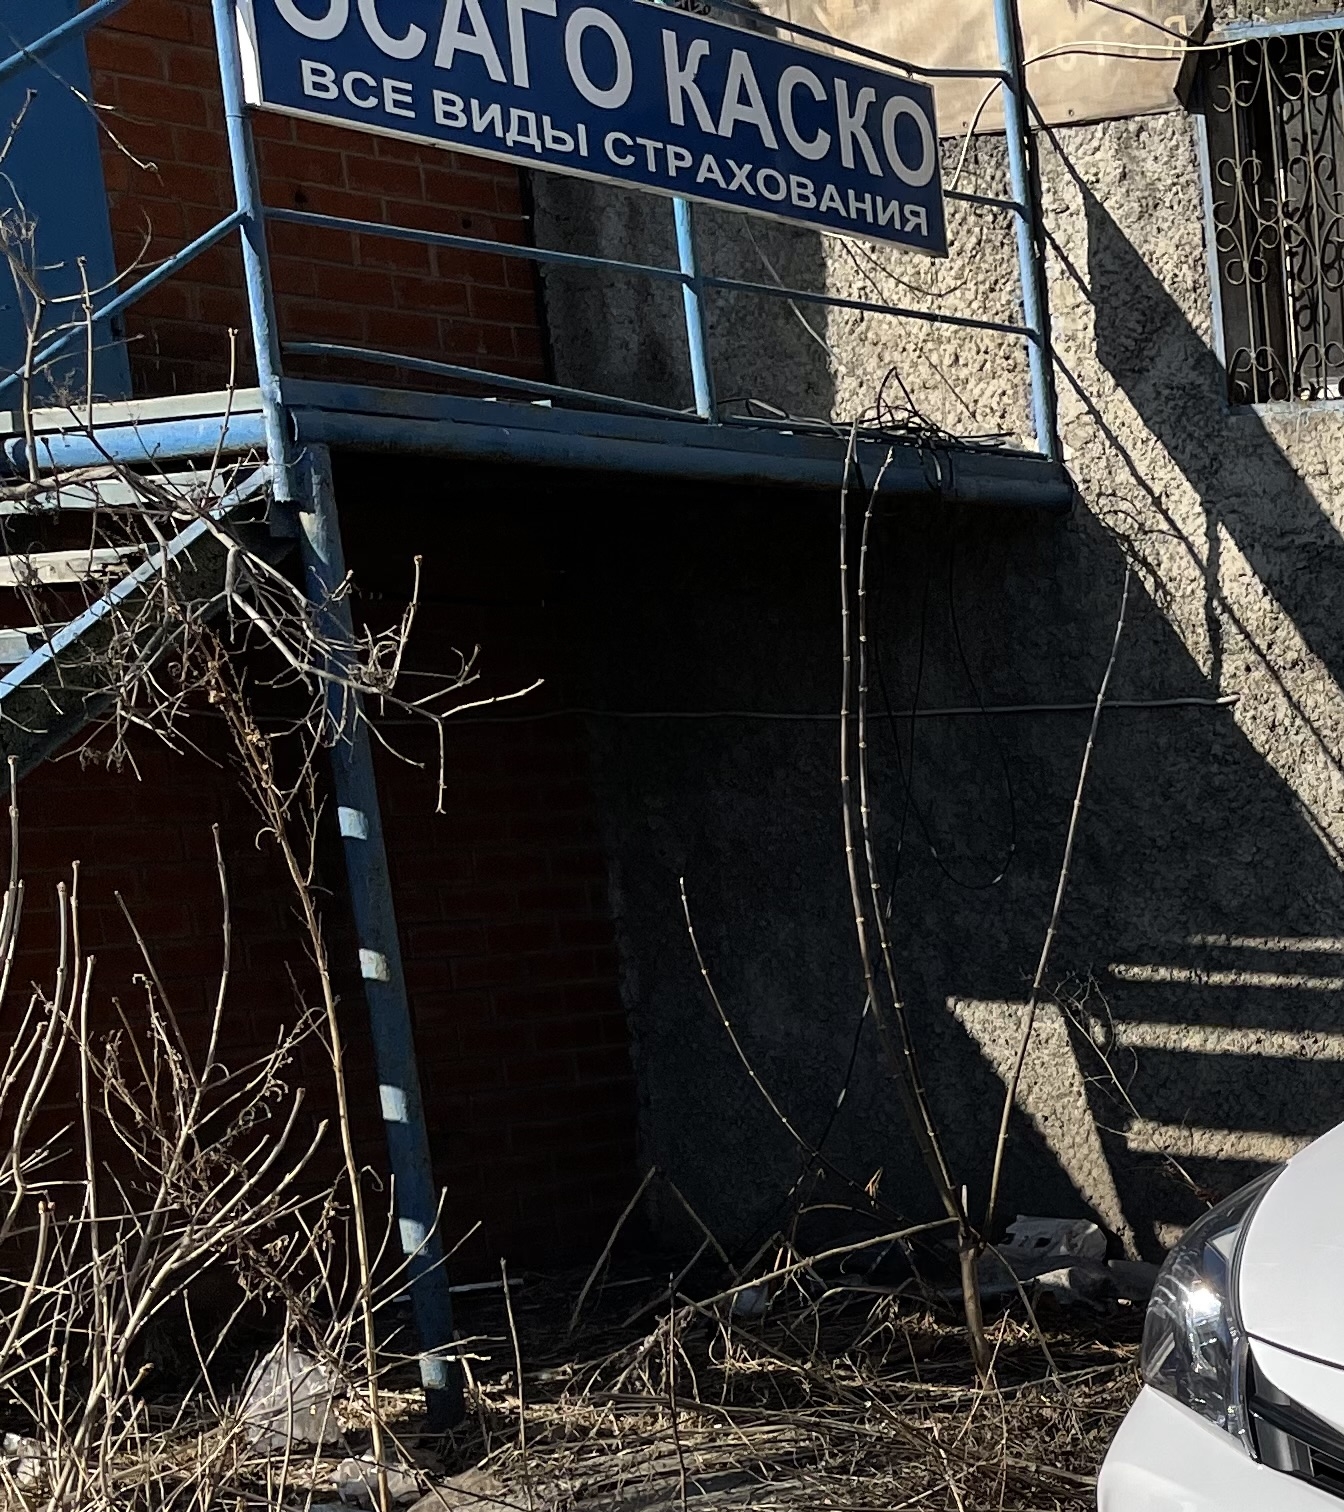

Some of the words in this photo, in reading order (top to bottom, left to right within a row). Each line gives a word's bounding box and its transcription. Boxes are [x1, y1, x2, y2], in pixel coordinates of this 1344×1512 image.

[300, 59, 416, 119] ВСЕ
[432, 89, 589, 157] ВИДЫ
[604, 131, 928, 237] СТРАХОВАНИЯ
[662, 29, 936, 187] КАСКО
